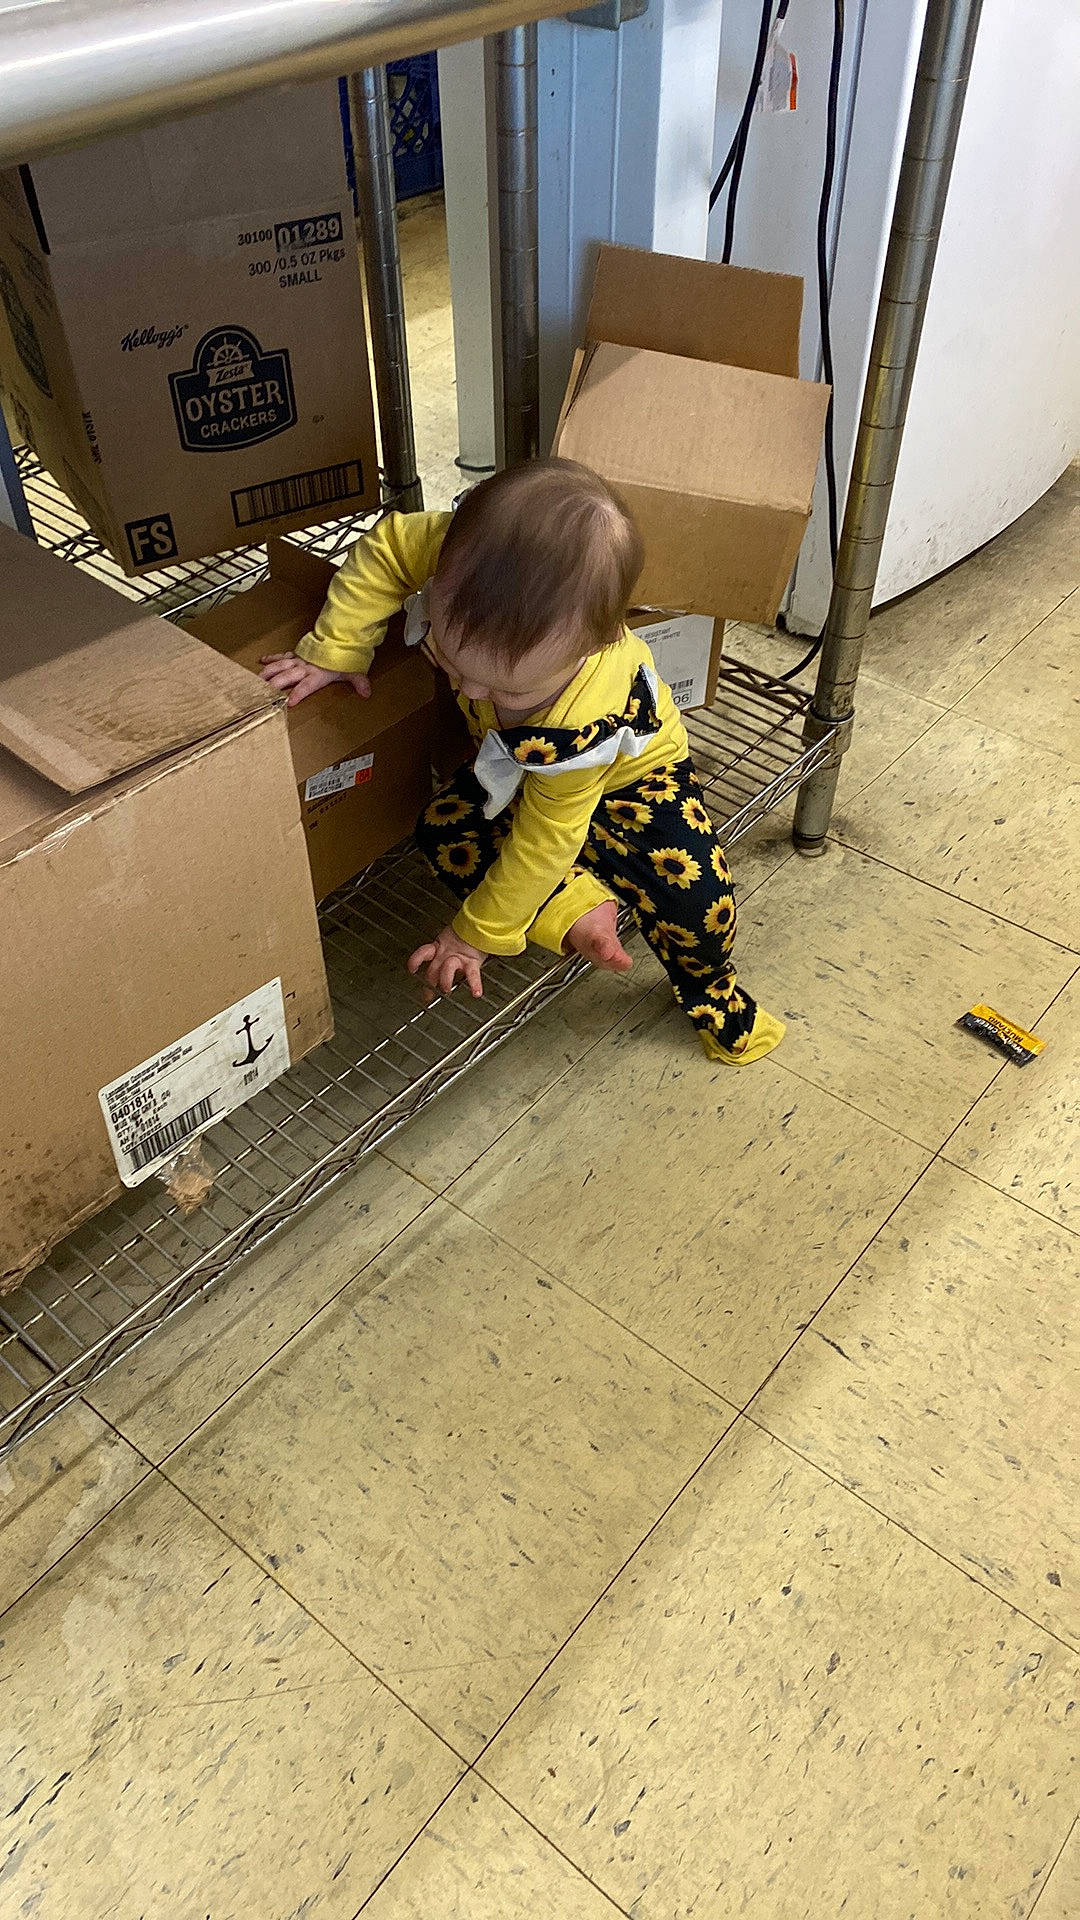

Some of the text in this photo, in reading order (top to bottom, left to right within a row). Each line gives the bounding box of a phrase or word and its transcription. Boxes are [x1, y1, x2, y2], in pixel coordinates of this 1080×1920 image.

[278, 217, 341, 248] 01289
[301, 251, 316, 266] OZ
[320, 247, 346, 263] Pkgs
[279, 269, 322, 288] SMALL
[121, 325, 185, 351] Kellogg's
[185, 379, 285, 422] OYSTER
[200, 409, 278, 439] CRACKERS
[130, 521, 173, 561] FS
[111, 1088, 154, 1124] 0401814
